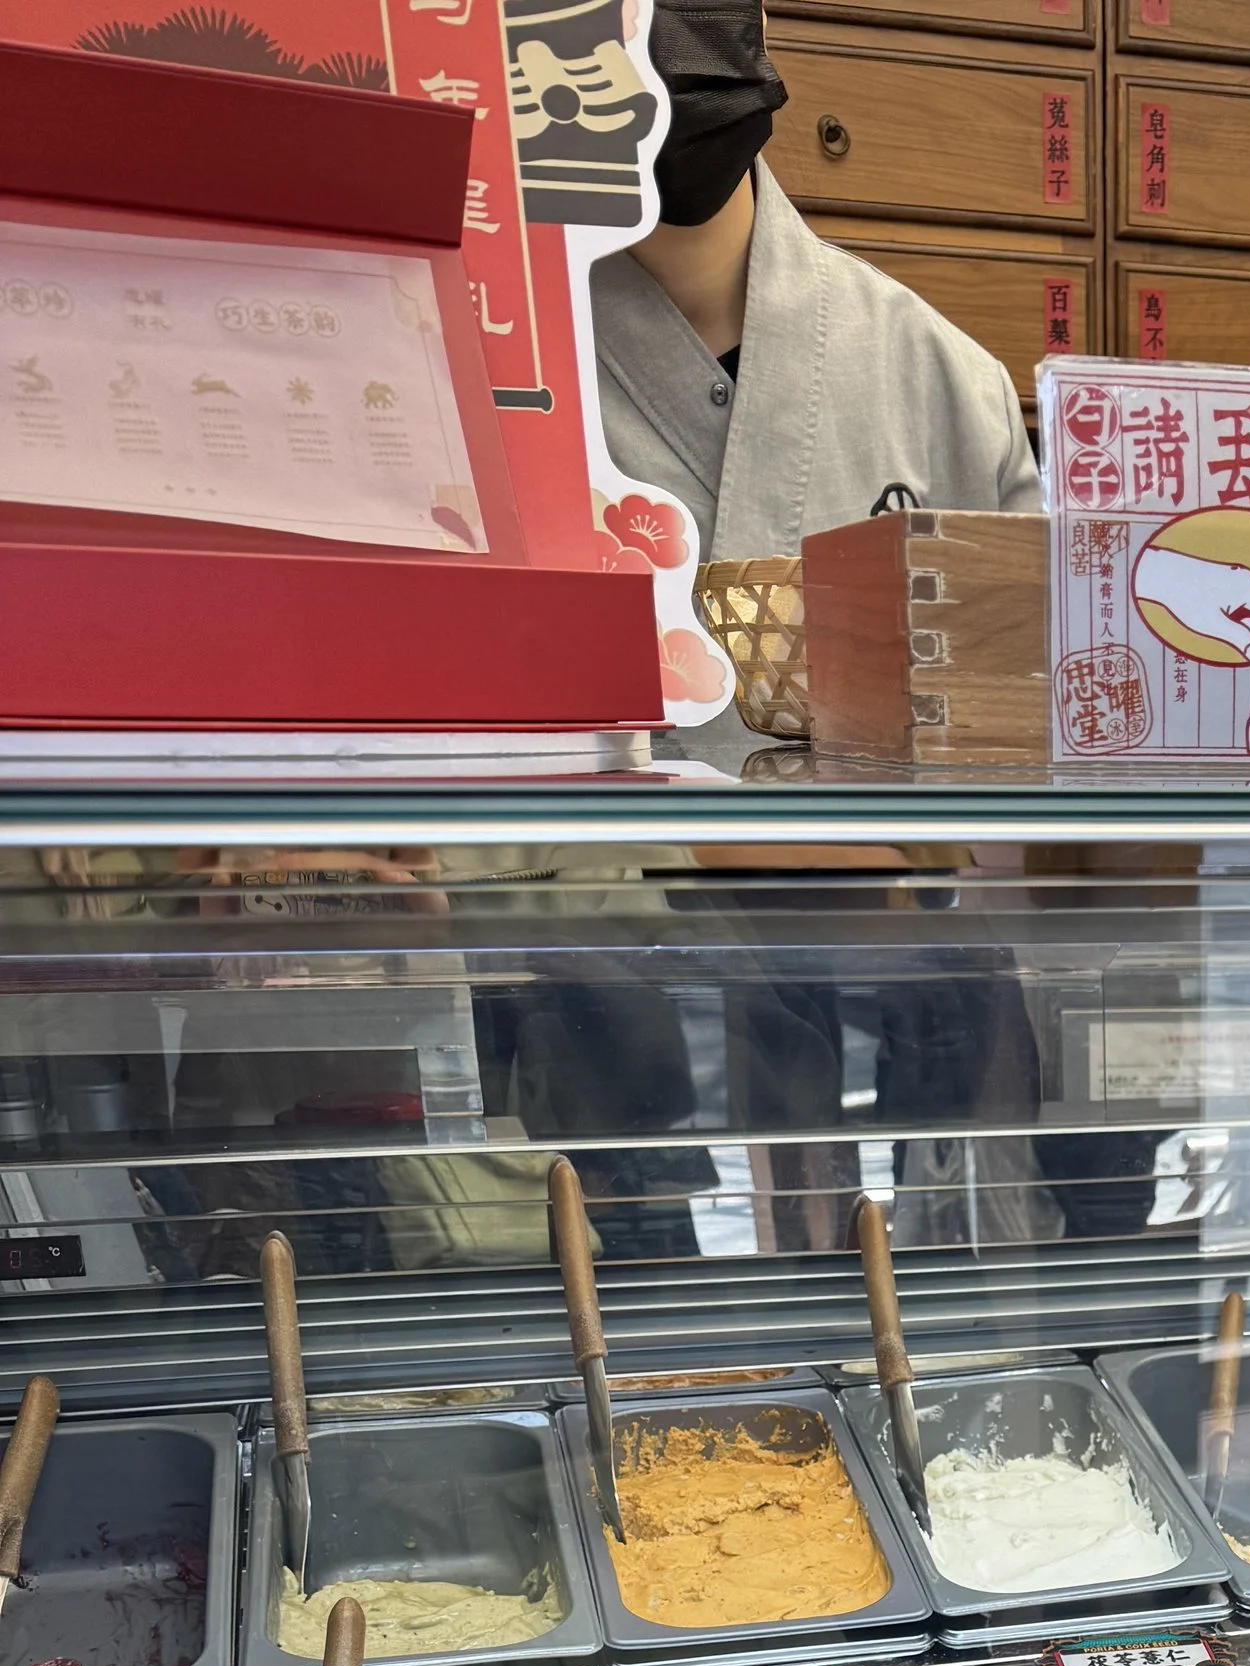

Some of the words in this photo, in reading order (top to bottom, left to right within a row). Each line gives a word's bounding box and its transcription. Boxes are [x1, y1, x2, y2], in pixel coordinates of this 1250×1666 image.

[1046, 97, 1069, 198] 菟絲子
[1145, 109, 1166, 208] 皂角刺
[1066, 388, 1120, 507] 勺子
